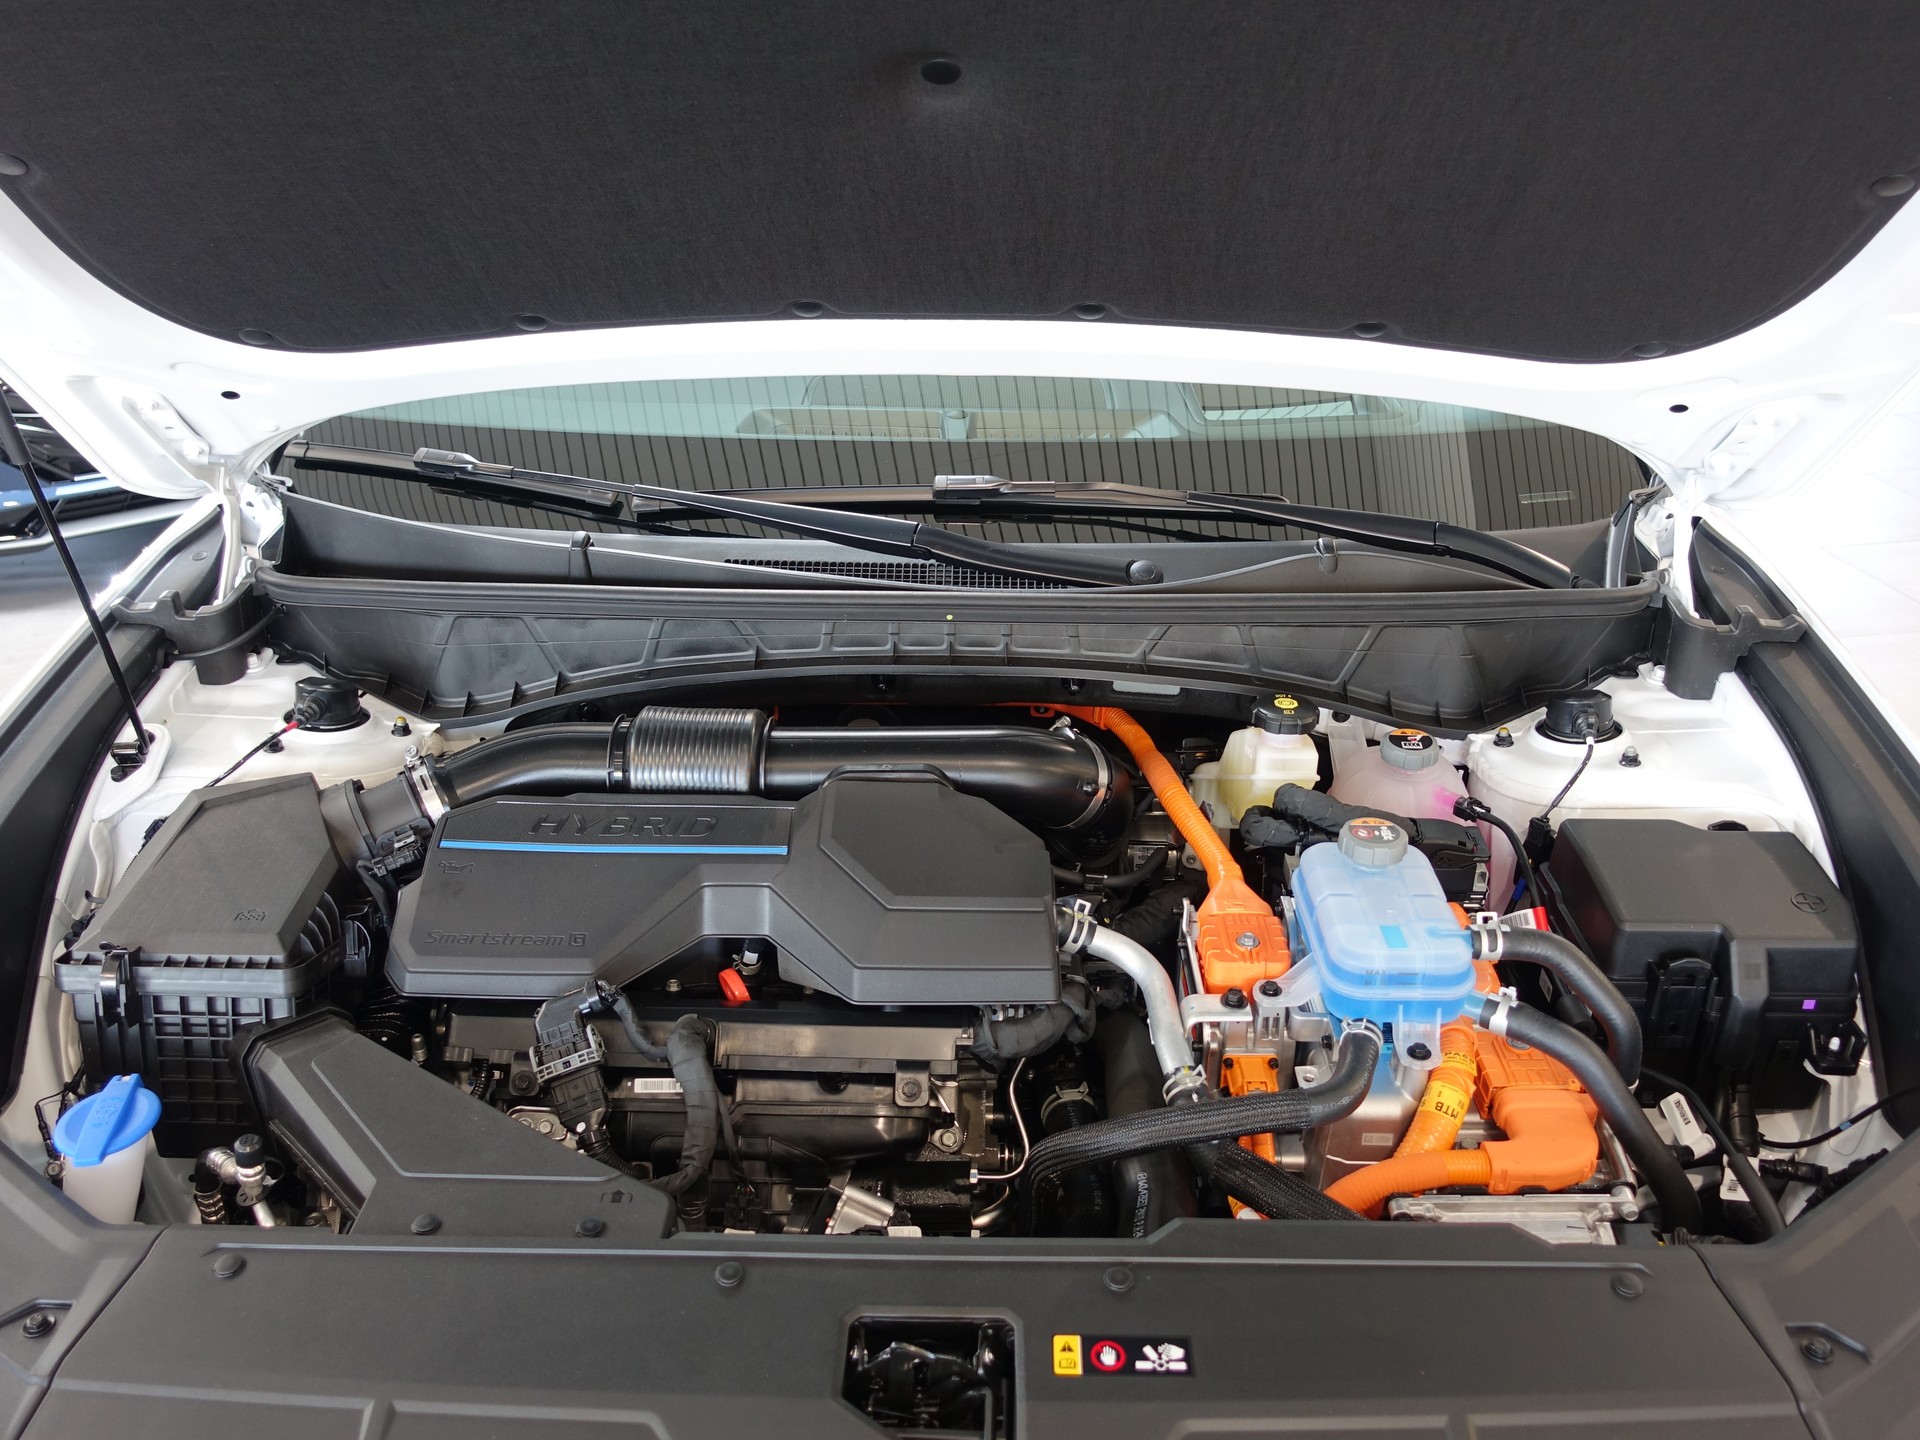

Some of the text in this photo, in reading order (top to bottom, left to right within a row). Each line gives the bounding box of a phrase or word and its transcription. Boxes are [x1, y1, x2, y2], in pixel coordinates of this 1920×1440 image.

[528, 814, 718, 837] HYBRID
[424, 930, 565, 946] Smartstream
[1434, 1101, 1459, 1120] MTB
